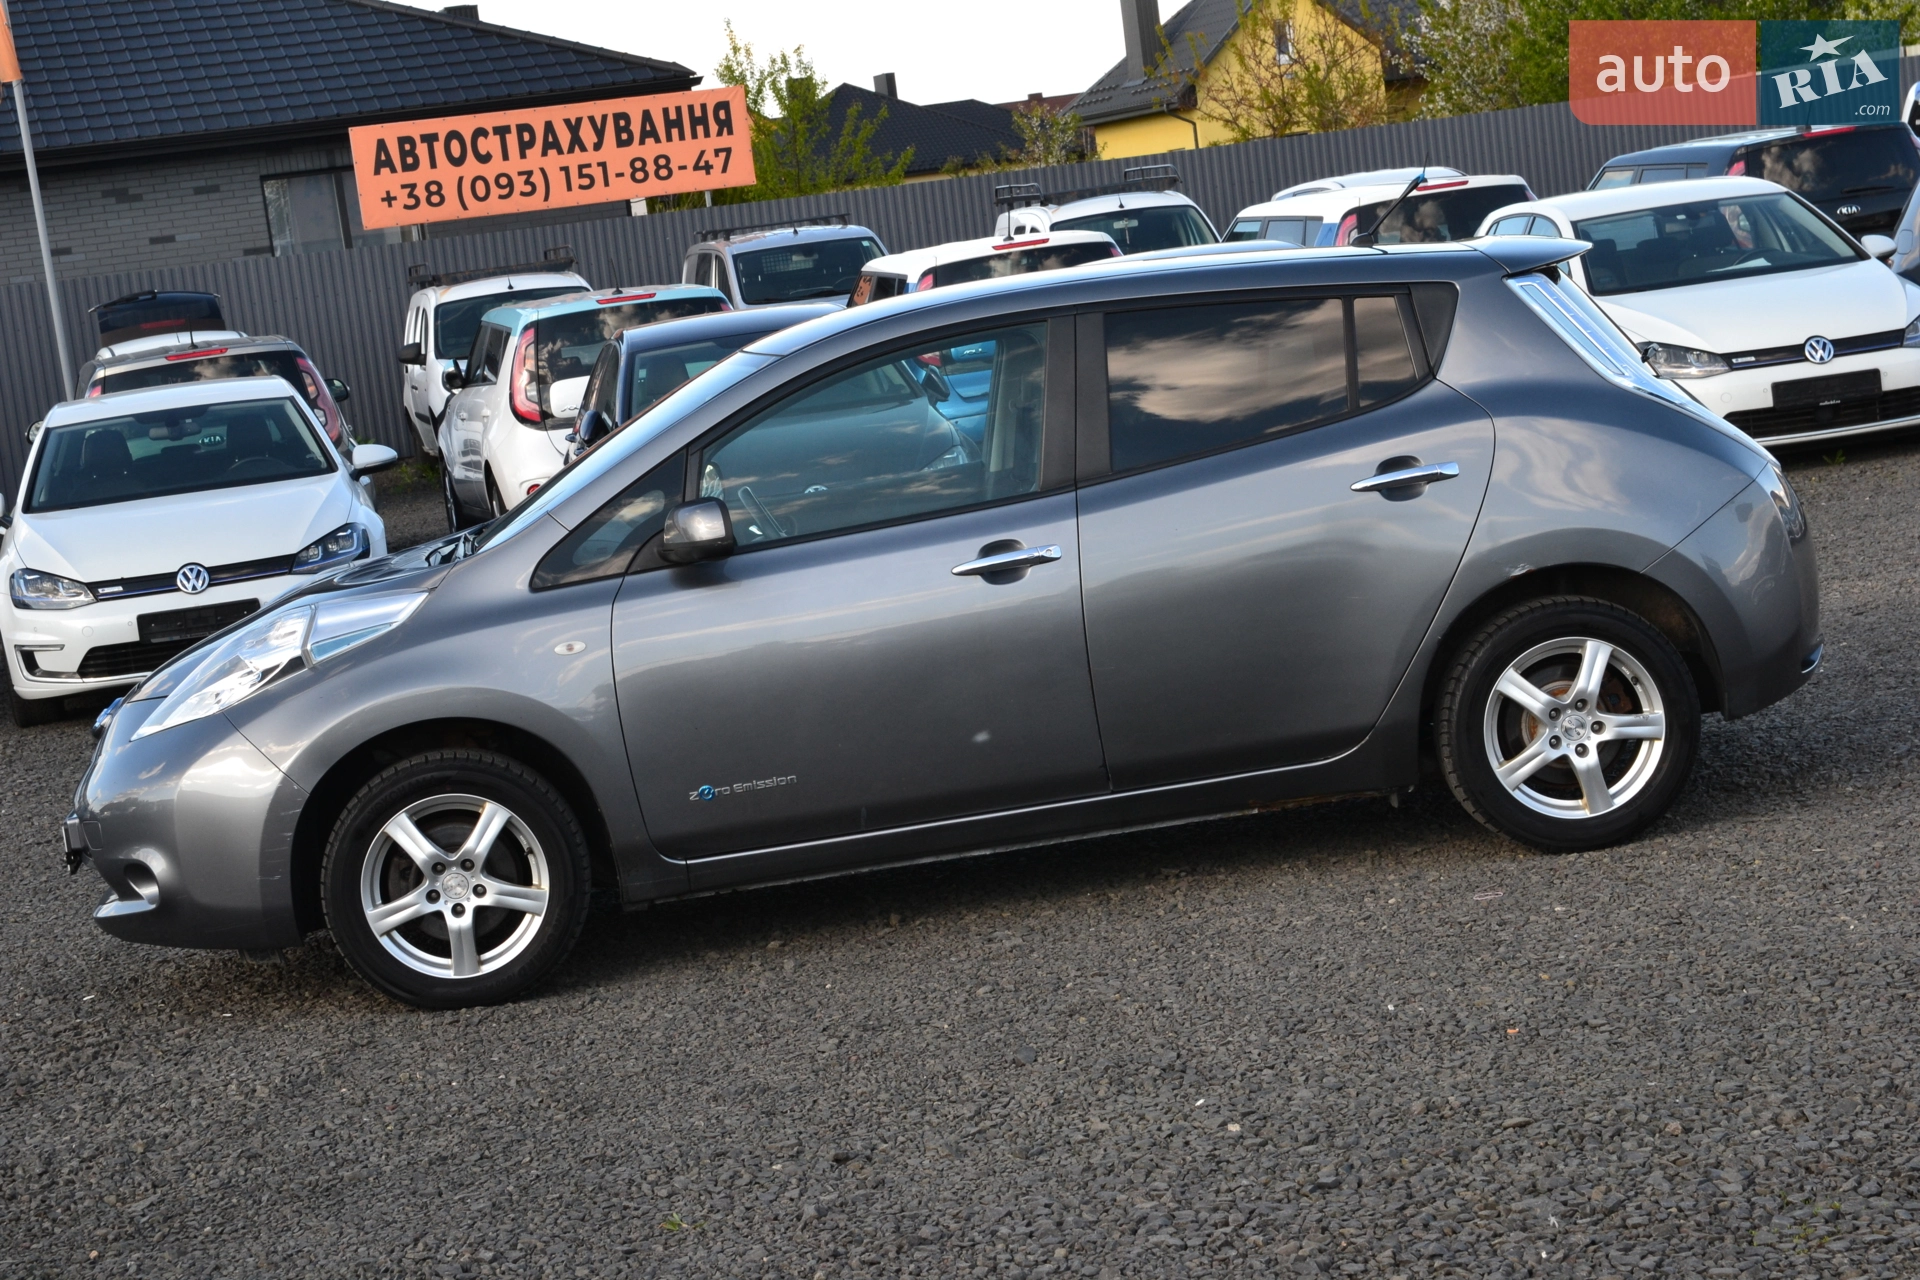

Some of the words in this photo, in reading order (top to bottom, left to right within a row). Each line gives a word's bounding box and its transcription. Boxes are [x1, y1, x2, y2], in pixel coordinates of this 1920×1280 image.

[373, 100, 734, 176] АВТОСТРАХУВАННЯ
[380, 180, 446, 211] +38
[456, 167, 551, 211] (093)
[560, 147, 734, 193] 151-88-47
[1839, 205, 1859, 215] KIA
[733, 775, 797, 793] Emission
